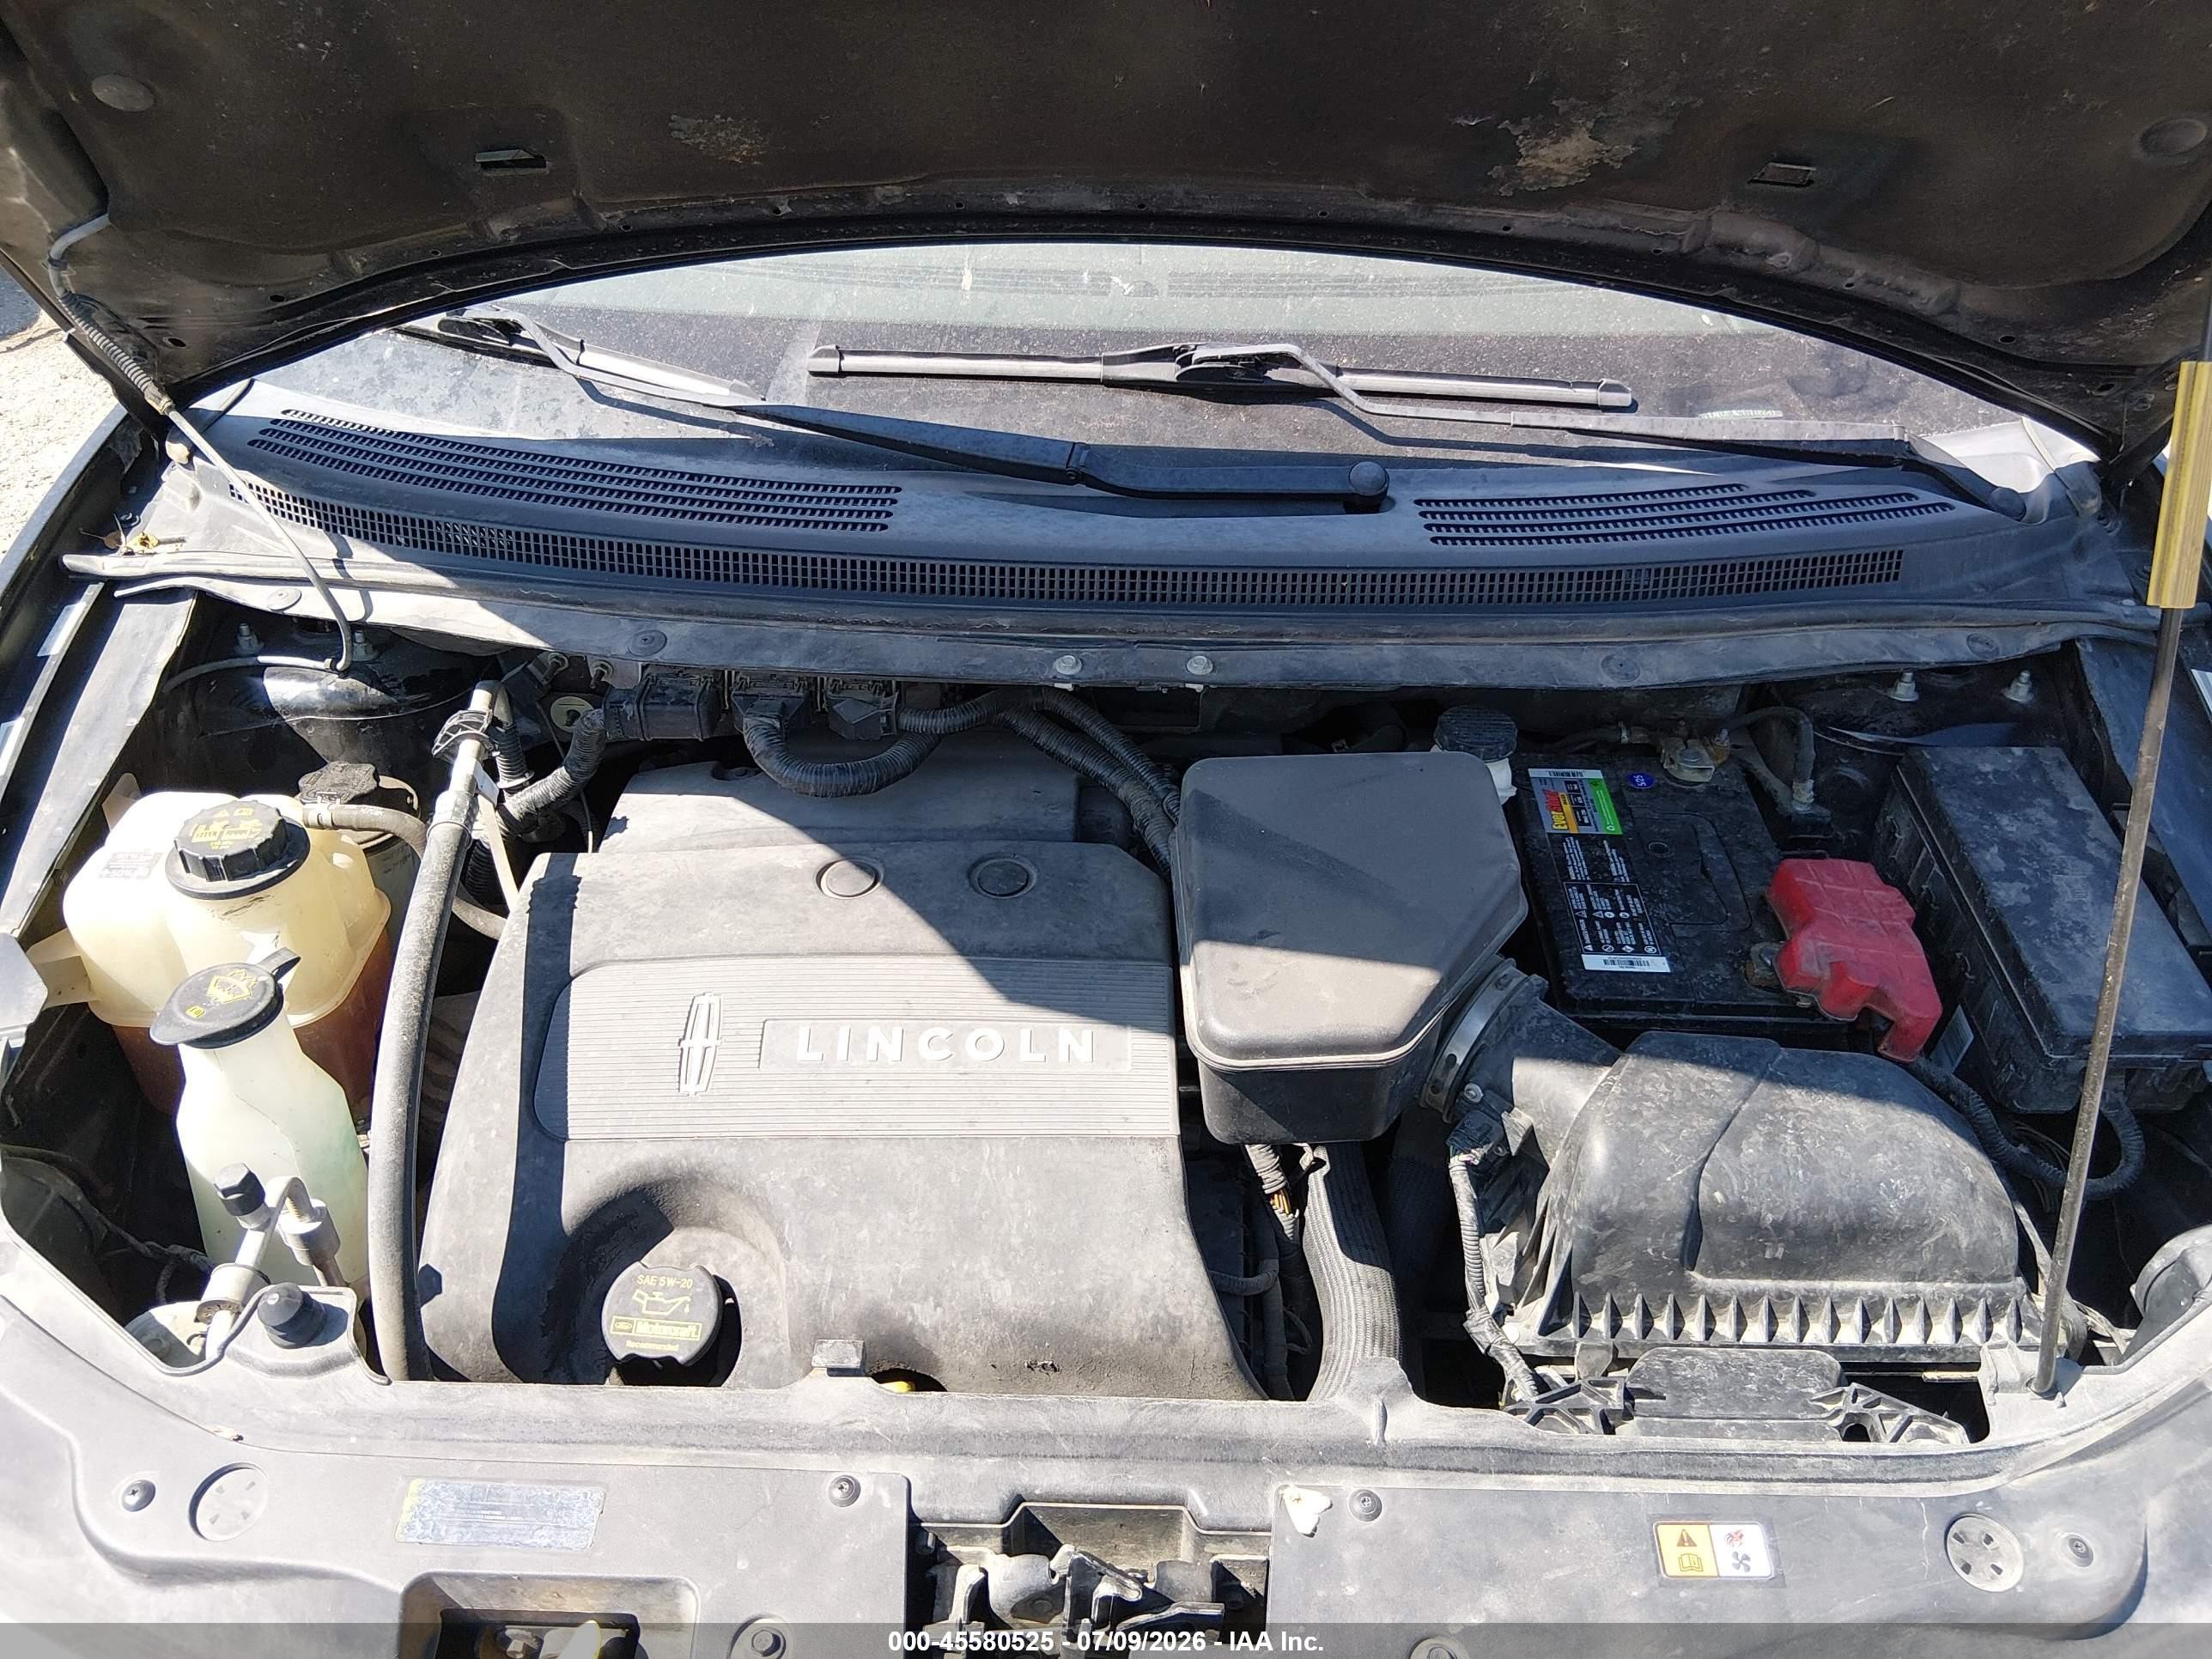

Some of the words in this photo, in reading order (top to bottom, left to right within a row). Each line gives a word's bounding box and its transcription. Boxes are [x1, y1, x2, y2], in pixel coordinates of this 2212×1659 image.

[796, 1026, 1094, 1062] LINCOLN
[636, 1274, 658, 1285] SAE
[659, 1276, 694, 1289] 5W-20
